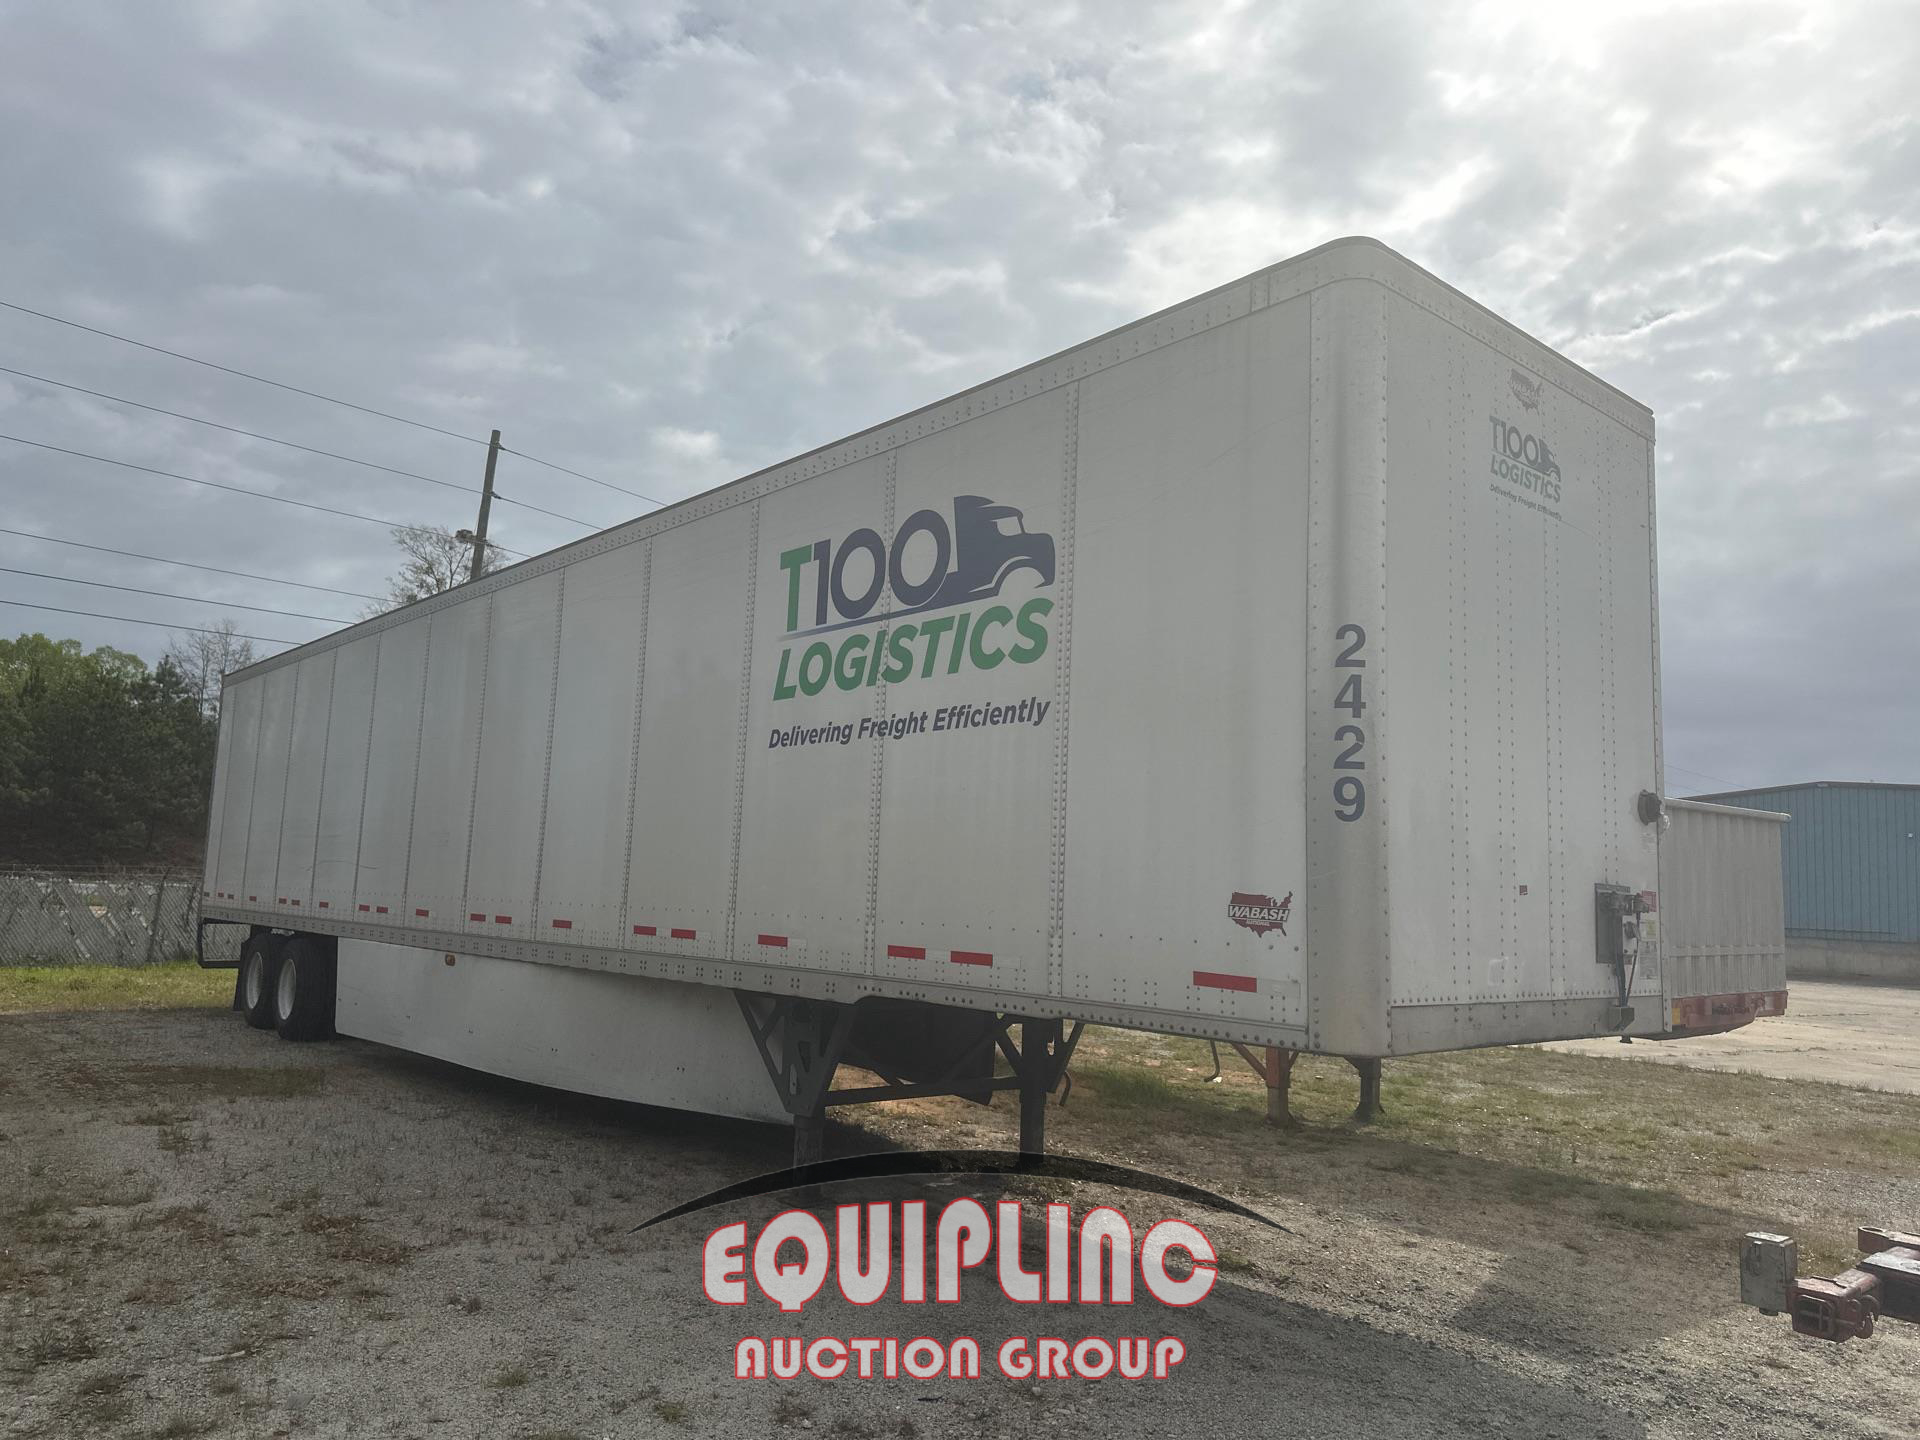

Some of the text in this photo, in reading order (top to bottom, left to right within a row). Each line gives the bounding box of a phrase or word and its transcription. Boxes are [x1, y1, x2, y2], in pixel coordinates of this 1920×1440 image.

[1490, 454, 1561, 503] LOGISTICS
[1537, 504, 1562, 521] Efftly
[780, 509, 951, 632] T100
[773, 598, 1054, 701] LOGISTICS
[768, 696, 1051, 748] Delivering Freight Efficiently
[1229, 905, 1290, 921] WABASH
